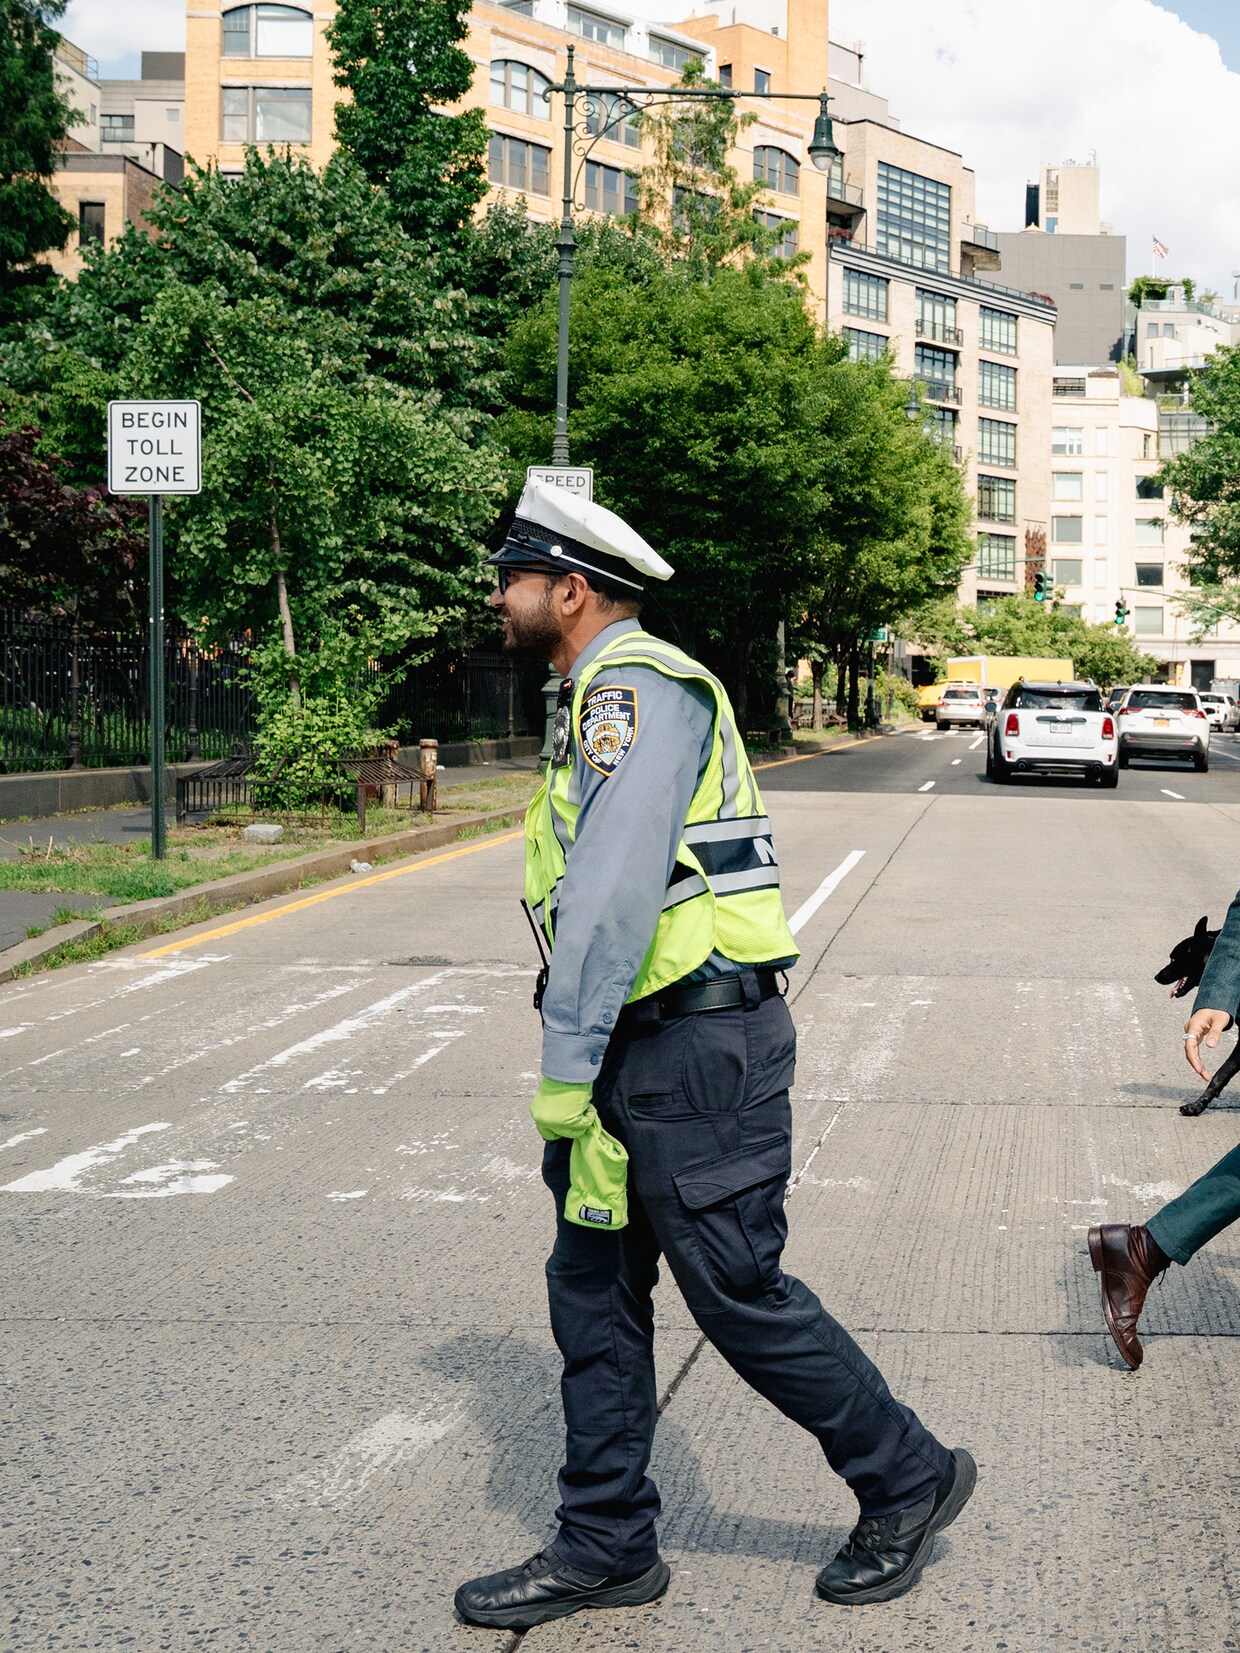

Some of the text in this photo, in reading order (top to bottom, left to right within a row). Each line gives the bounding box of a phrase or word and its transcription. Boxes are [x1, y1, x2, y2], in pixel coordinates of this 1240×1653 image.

[121, 412, 188, 428] BEGIN
[126, 439, 183, 455] TOLL
[125, 466, 185, 482] ZONE
[587, 690, 623, 707] TRAFFIC
[590, 704, 620, 718] POLICE
[582, 712, 631, 731] DEPARTMENT
[583, 740, 602, 764] CITY OF
[613, 726, 635, 766] NEW YORK
